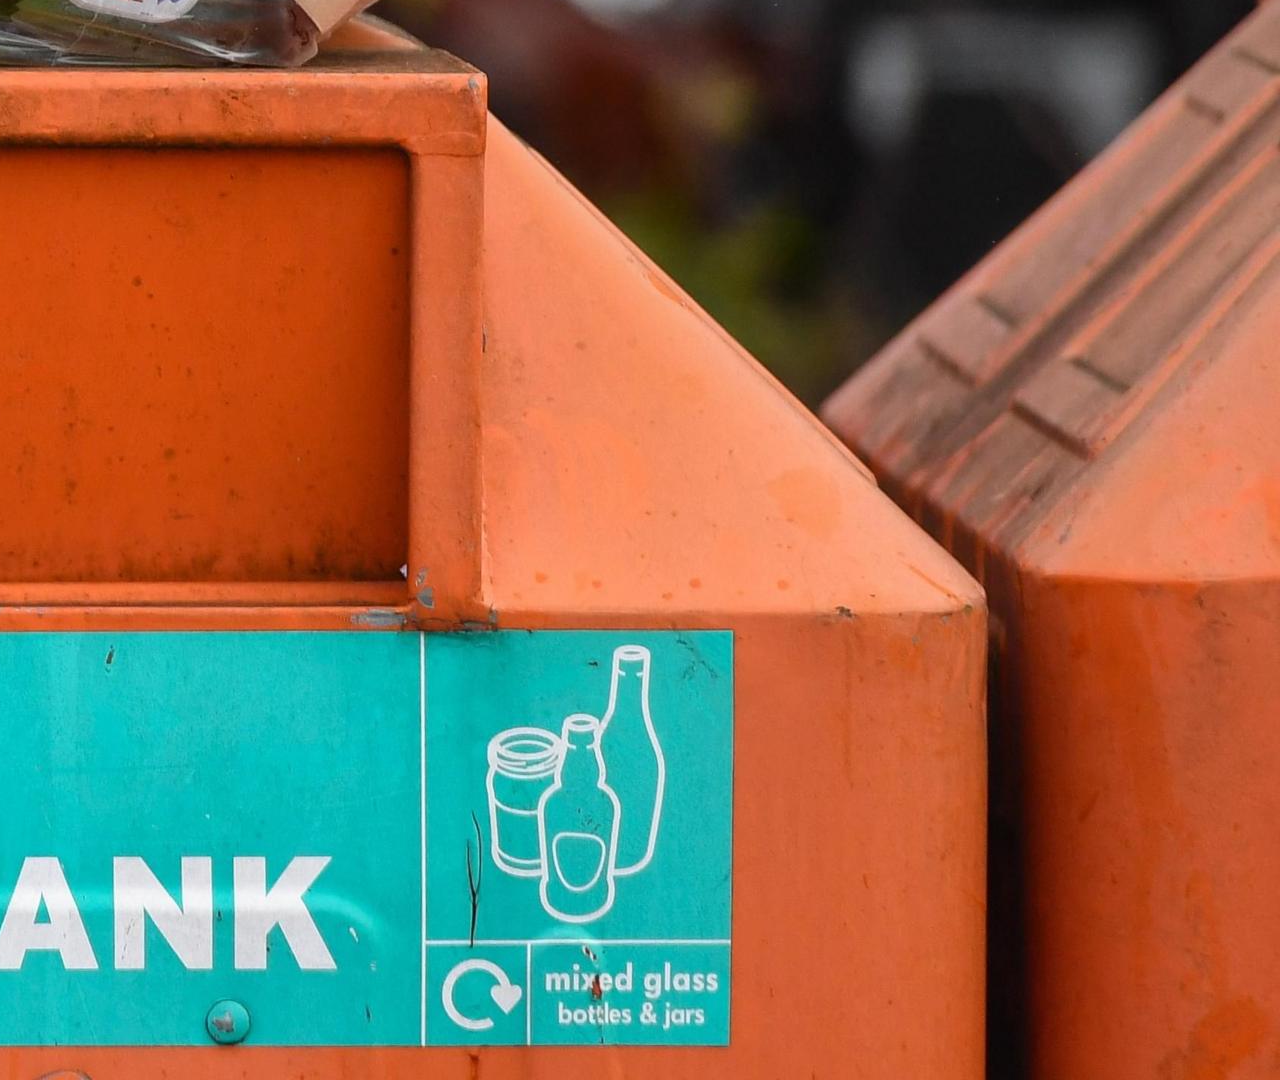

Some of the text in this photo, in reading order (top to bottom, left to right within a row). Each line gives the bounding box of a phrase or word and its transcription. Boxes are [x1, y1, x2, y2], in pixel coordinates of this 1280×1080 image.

[545, 962, 719, 999] mixed glass
[557, 1001, 705, 1030] bottles & jars
